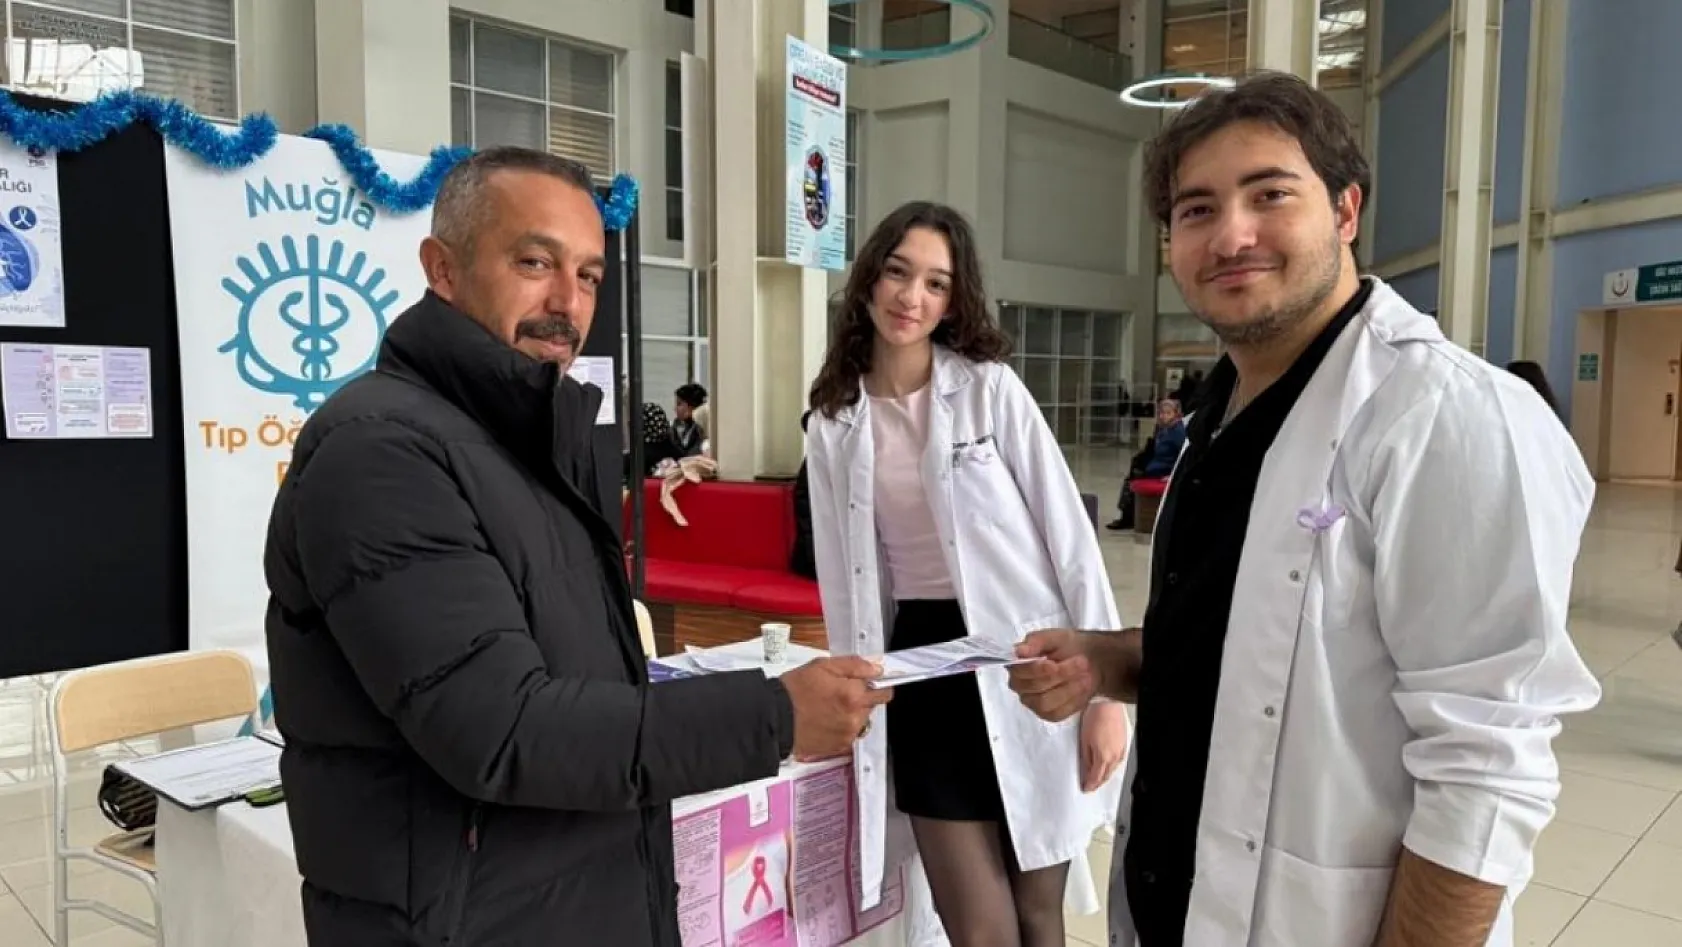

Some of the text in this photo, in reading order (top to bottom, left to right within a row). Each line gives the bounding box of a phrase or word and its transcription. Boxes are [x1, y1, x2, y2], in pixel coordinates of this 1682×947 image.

[0, 179, 32, 193] LIĞI
[245, 175, 376, 231] Muğla
[199, 420, 247, 455] Tıp
